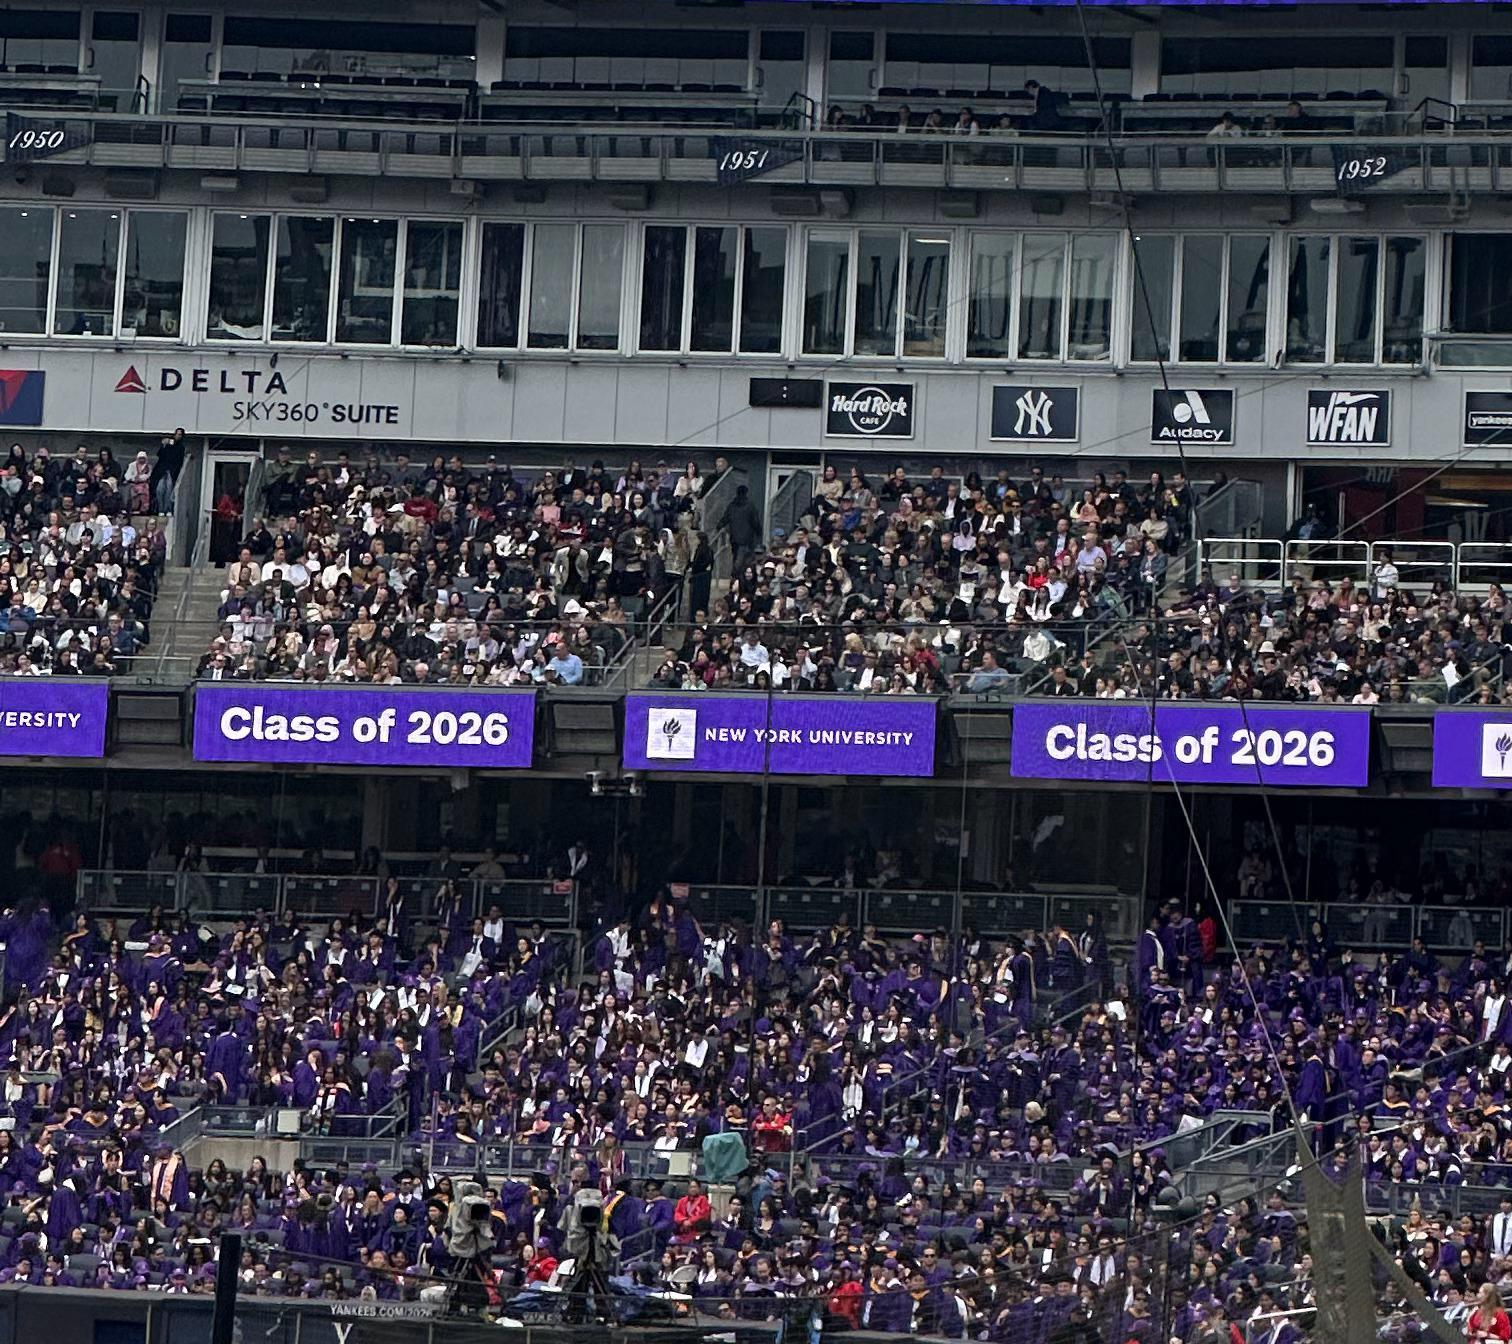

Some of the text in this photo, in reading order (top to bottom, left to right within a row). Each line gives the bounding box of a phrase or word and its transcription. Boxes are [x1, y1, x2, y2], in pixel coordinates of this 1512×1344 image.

[10, 130, 65, 149] 1950
[720, 150, 769, 171] 1951
[1338, 156, 1387, 181] 1952
[160, 367, 288, 395] DELTA
[331, 403, 400, 425] SUITE
[832, 394, 907, 417] Hard Rock
[859, 416, 880, 426] CAFE
[1309, 406, 1378, 442] WFAN
[1158, 426, 1225, 442] Audacy
[220, 705, 508, 746] Class of 2026
[705, 728, 913, 746] NEW YORK UNIVERSITY
[1046, 722, 1335, 767] Class of 2026
